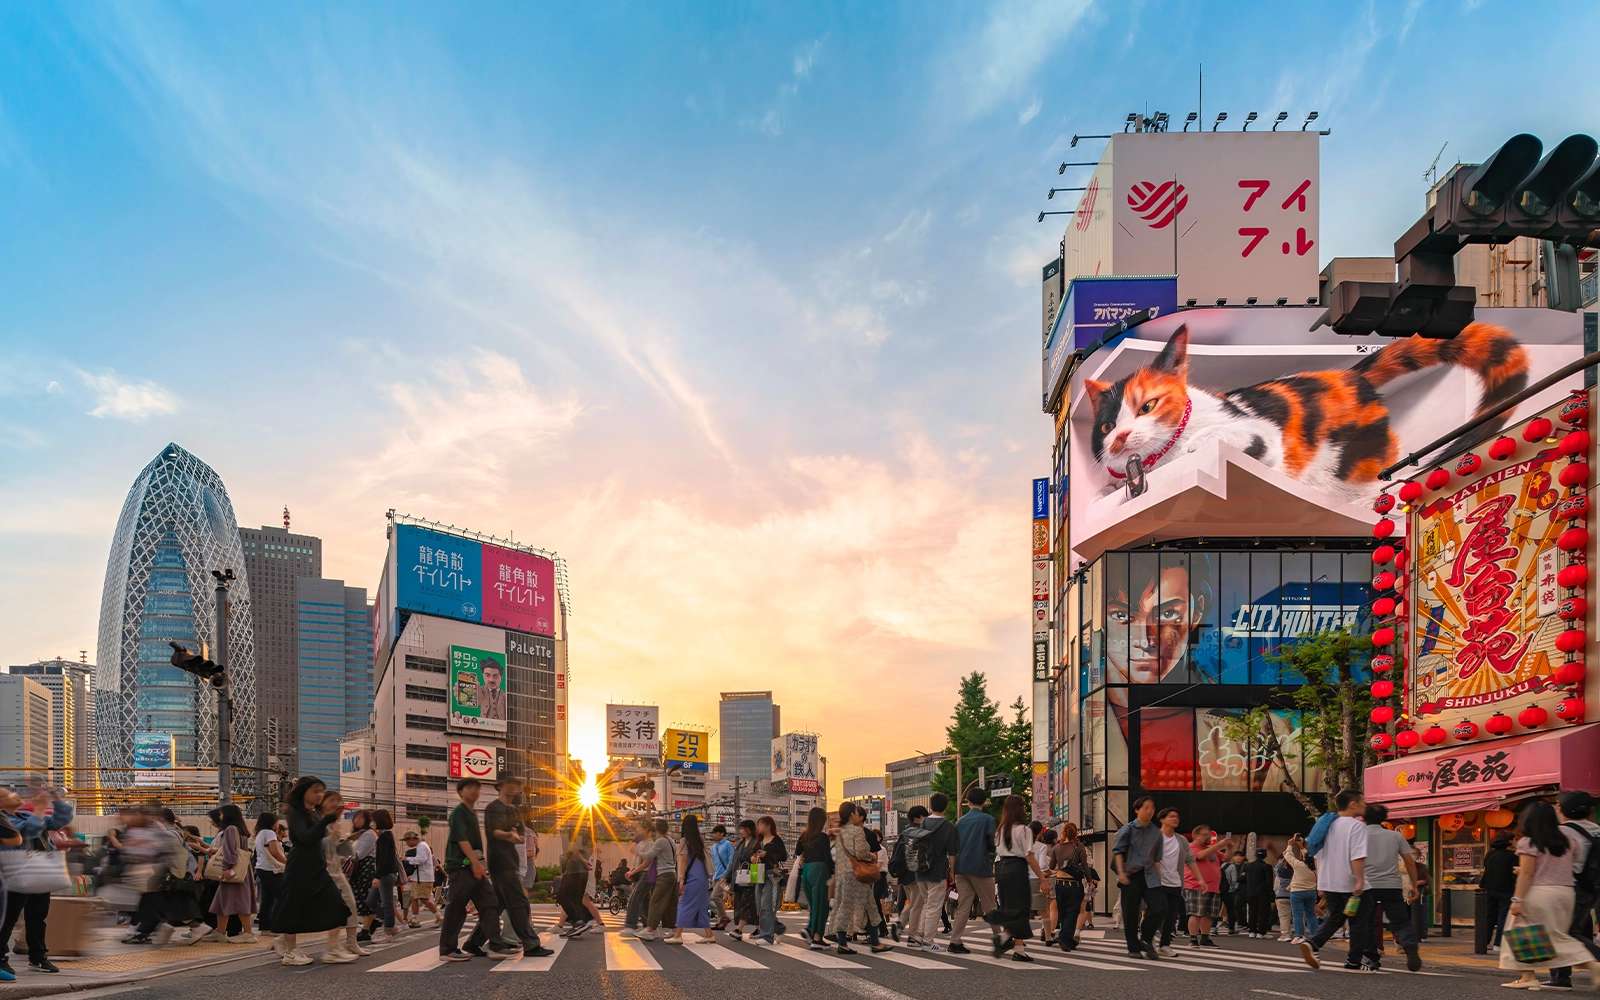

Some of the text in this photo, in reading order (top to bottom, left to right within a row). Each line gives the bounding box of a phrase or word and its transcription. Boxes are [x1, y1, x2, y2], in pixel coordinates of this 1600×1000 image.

[1238, 179, 1312, 211] アイ
[1238, 227, 1314, 257] フル
[1447, 462, 1531, 504] YATAIEN
[419, 545, 463, 571] 龍角散
[413, 564, 472, 592] ダイレクト
[499, 563, 538, 588] 龍角散
[1233, 604, 1280, 632] CITY
[1445, 681, 1529, 707] SHINJUKU
[610, 719, 656, 740] 楽待
[677, 733, 699, 745] プロ
[464, 757, 494, 766] スシロー
[677, 745, 698, 758] ミス
